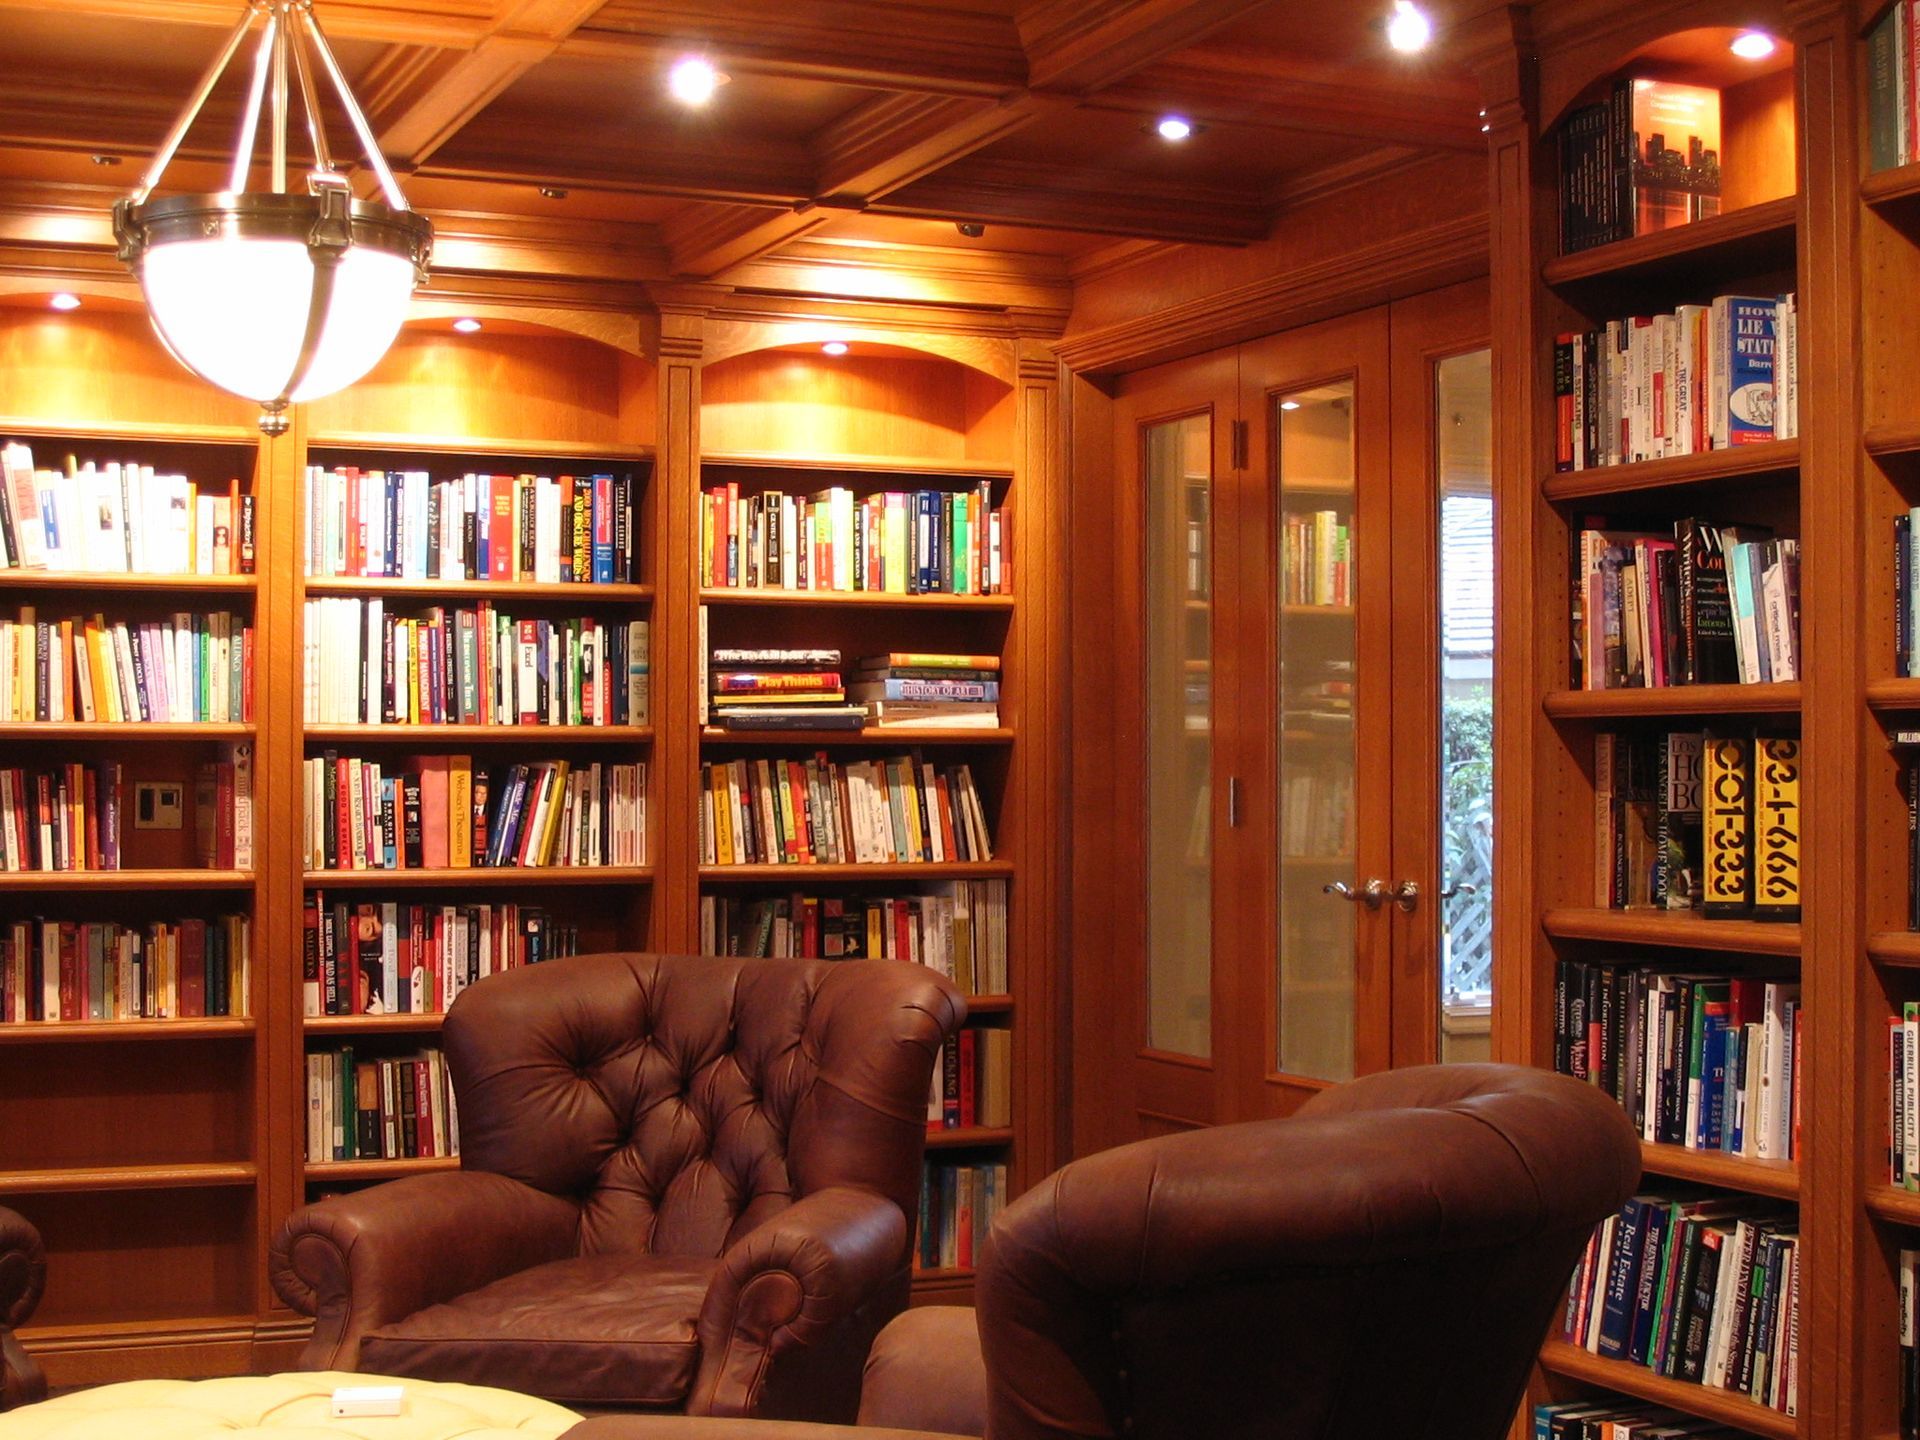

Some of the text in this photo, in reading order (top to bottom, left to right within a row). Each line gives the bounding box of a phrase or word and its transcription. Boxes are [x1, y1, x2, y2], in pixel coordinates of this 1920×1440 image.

[1736, 318, 1763, 335] LIE
[1574, 377, 1583, 430] SELLING
[1679, 367, 1687, 412] THE GREAT
[1681, 531, 1694, 597] Writer's
[1772, 601, 1780, 634] critical
[134, 662, 144, 685] FOCUS
[419, 629, 430, 712] PROJECT MANAGEMENT
[524, 646, 533, 668] Excel
[757, 675, 823, 688] PlayThinks
[907, 686, 969, 697] HISTORY OF ART
[1671, 740, 1697, 753] LOS
[1658, 768, 1667, 823] ANGELES
[456, 811, 465, 855] Thesaurus
[1657, 825, 1668, 864] HOME
[1657, 865, 1668, 901] BOOK
[327, 960, 335, 976] MAD
[327, 985, 335, 1004] HELL
[1558, 981, 1566, 1036] COMPETITIVE
[1637, 1015, 1645, 1055] CREATIVE
[1906, 1029, 1915, 1138] GUERRILLA PUBLICITY
[1621, 1223, 1636, 1257] Real
[1650, 1226, 1660, 1244] THE
[1740, 1224, 1755, 1263] PETER
[1614, 1258, 1631, 1302] Estate
[1641, 1281, 1653, 1312] FACTOR
[1735, 1264, 1750, 1302] LYNCH
[1900, 1286, 1908, 1337] Simplicity
[1686, 1315, 1698, 1356] STEWART
[1725, 1350, 1738, 1375] Street
